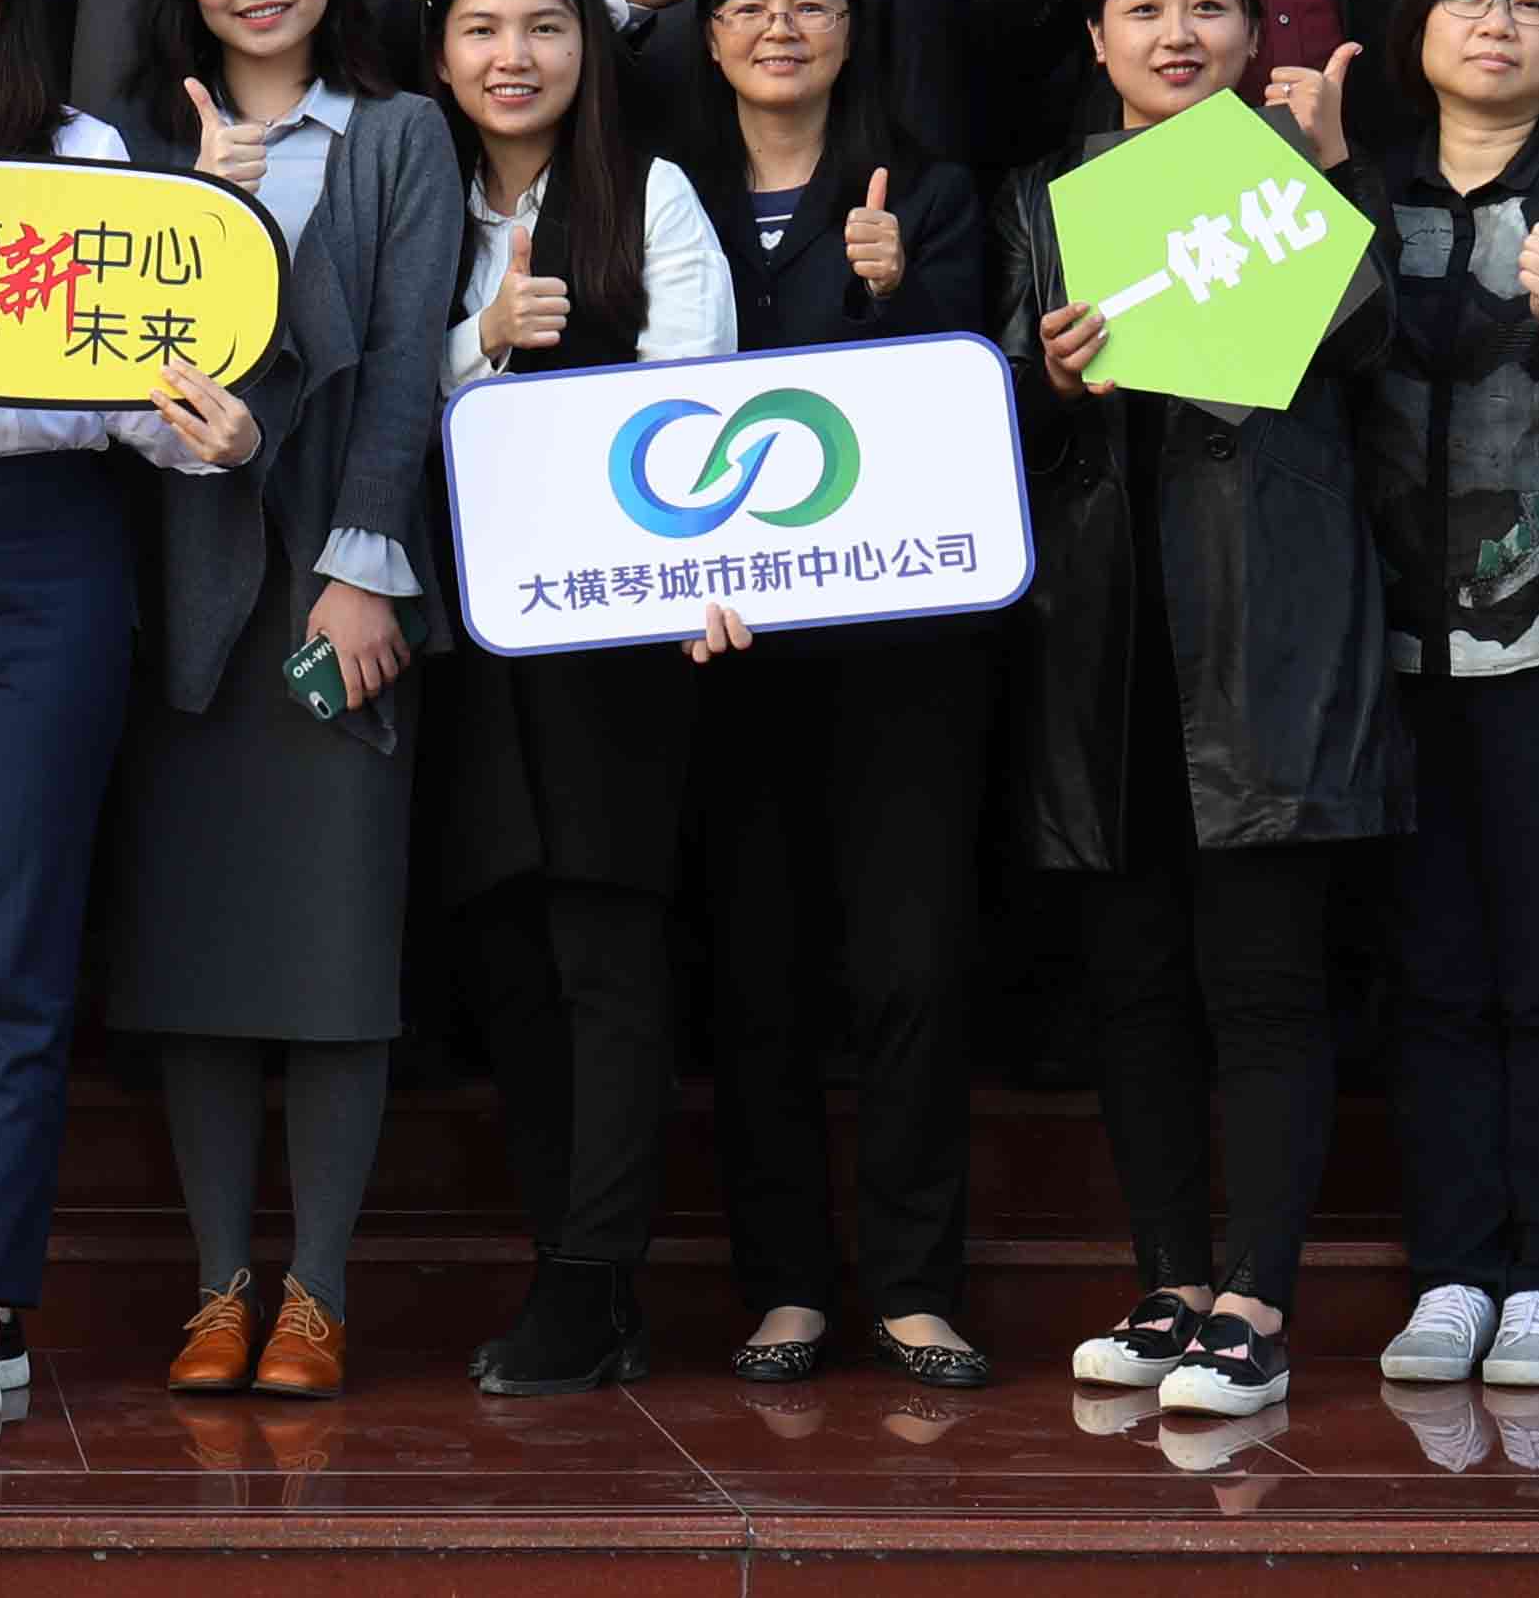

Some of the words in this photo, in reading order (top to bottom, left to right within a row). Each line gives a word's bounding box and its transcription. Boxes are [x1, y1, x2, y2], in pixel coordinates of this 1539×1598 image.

[1097, 177, 1328, 321] 一体化
[519, 533, 977, 615] 大横琴城市新中心公司
